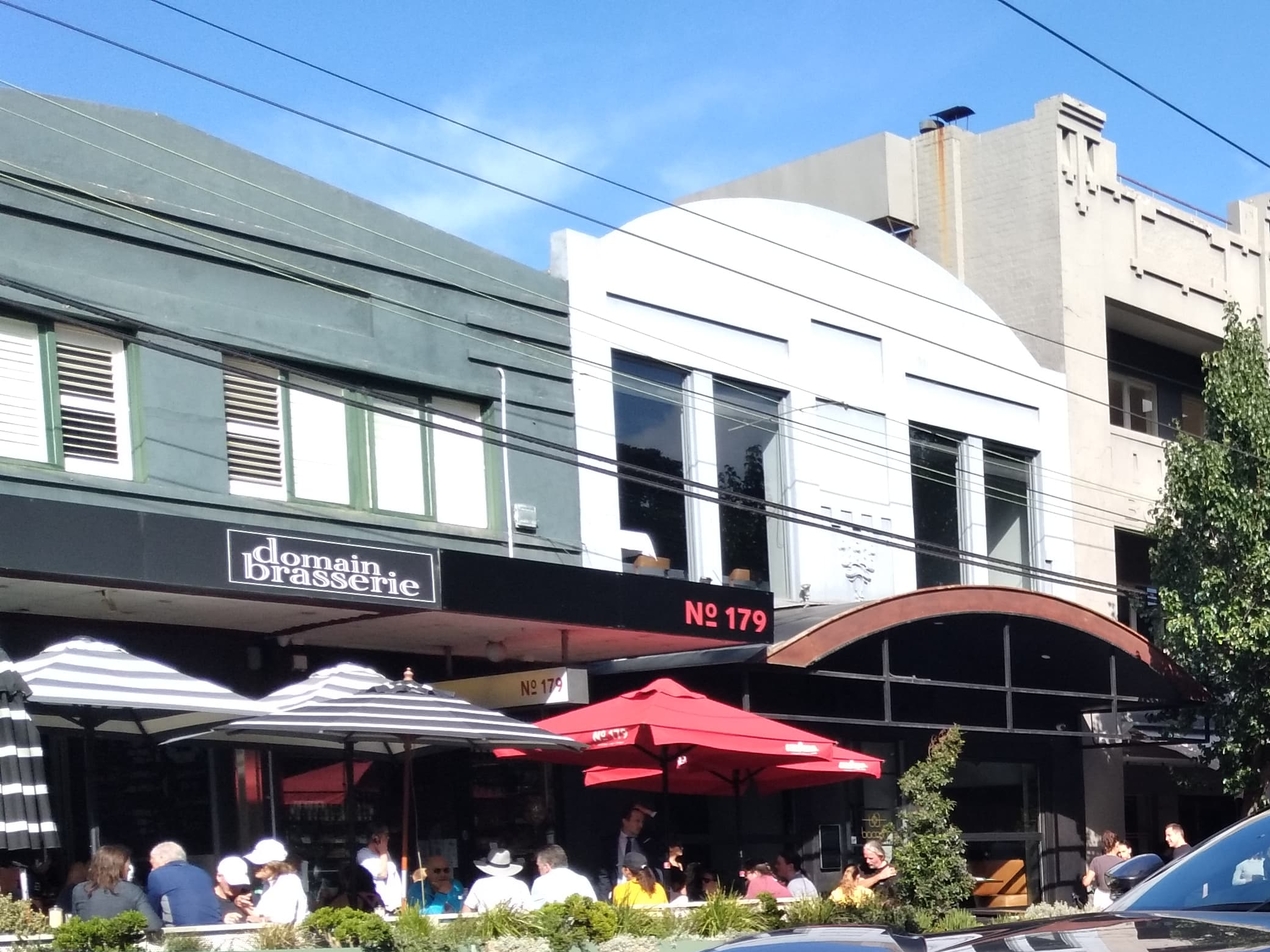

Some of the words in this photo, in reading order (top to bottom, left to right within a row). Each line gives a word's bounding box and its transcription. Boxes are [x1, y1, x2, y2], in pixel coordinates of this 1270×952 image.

[252, 537, 382, 576] domain
[241, 552, 420, 597] brasserie
[725, 606, 767, 633] 179
[541, 677, 563, 694] 179
[608, 728, 628, 740] 179
